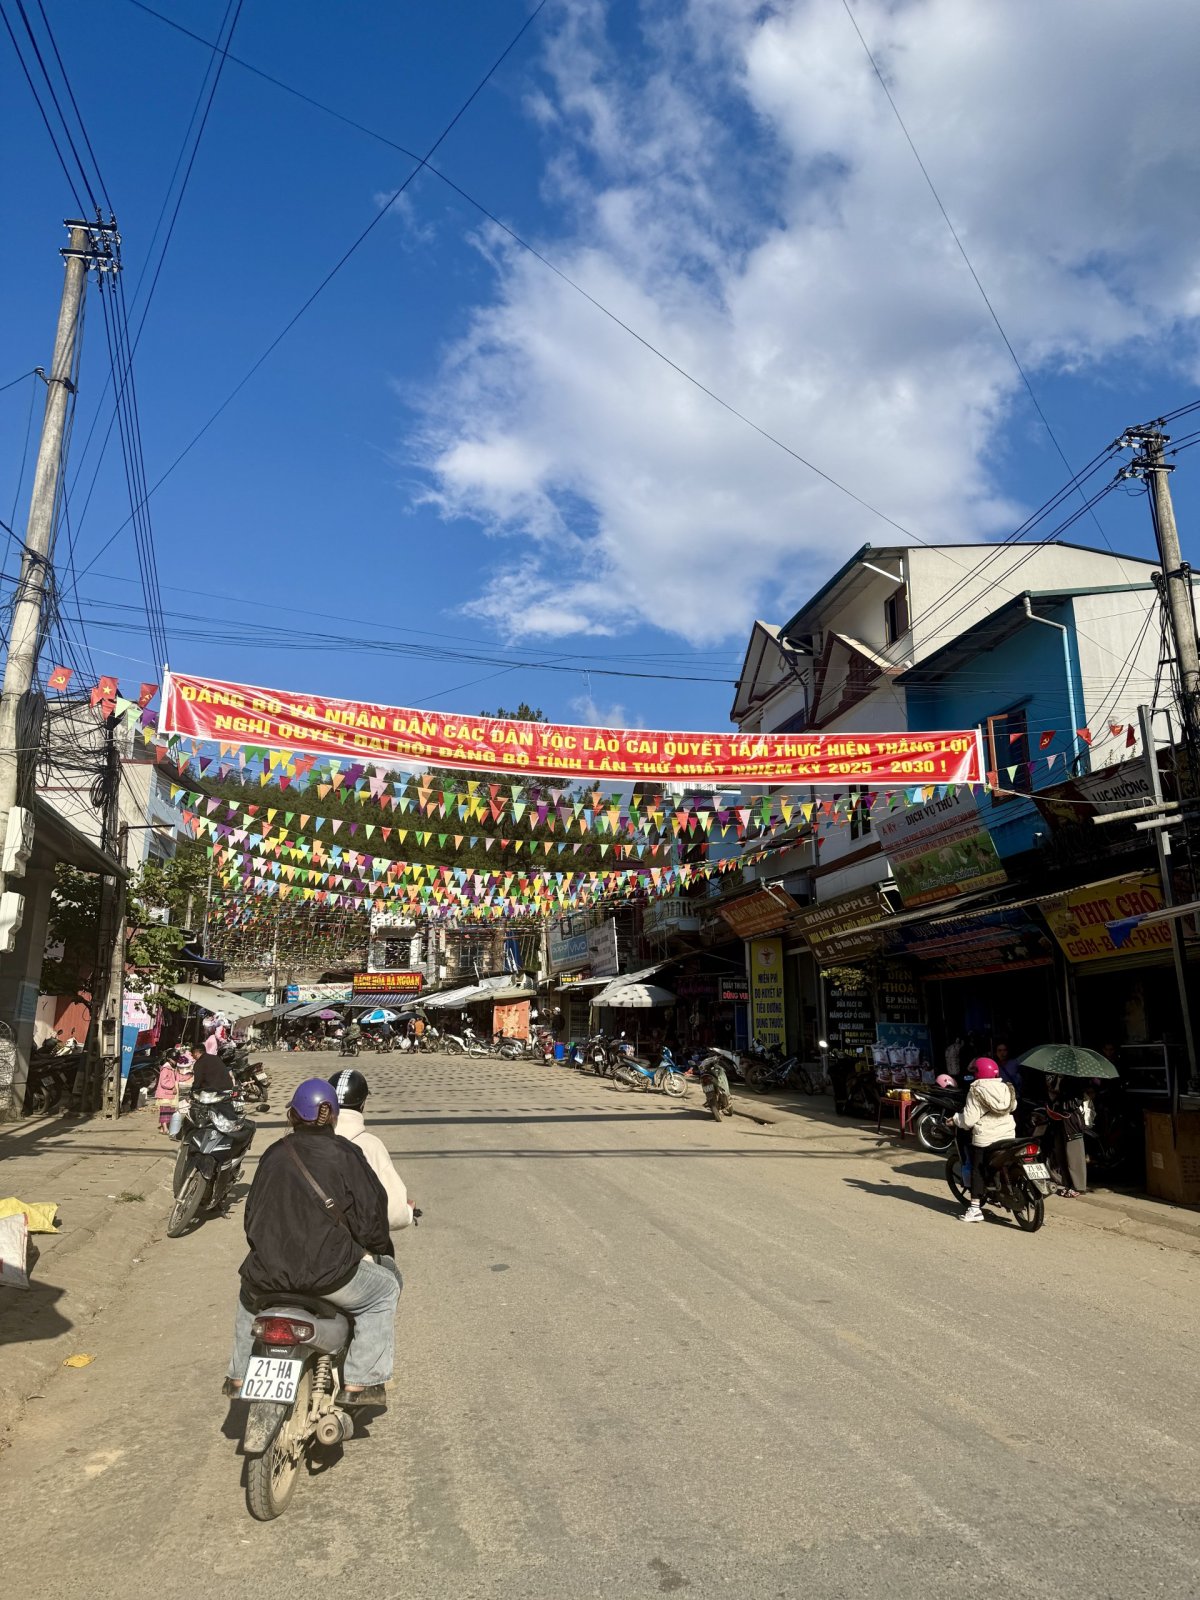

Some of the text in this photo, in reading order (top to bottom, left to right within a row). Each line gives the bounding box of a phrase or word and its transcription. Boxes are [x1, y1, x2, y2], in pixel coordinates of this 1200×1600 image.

[181, 684, 968, 760] ĐẢNG BỘ VÀ NHÂN DÂN CÁC DÂN TỘC LÀO CAI QUYẾT TÂM THỰC HIỆN THẮNG LỢI
[214, 714, 270, 738] NGHỊ
[278, 723, 348, 745] QUYẾT
[354, 735, 390, 752] ĐẠI
[397, 740, 432, 758] HỘI
[438, 743, 496, 763] ĐẢNG
[503, 751, 530, 768] BỘ
[536, 752, 582, 769] TỈNH
[588, 755, 626, 772] LẦN
[632, 760, 670, 774] THỨ
[676, 760, 726, 775] NHẤT
[732, 763, 793, 777] NHIỆM
[799, 761, 821, 774] KỲ
[828, 761, 872, 774] 2025
[891, 760, 935, 774] 2030
[941, 761, 947, 773] !
[905, 810, 924, 826] DỊCH
[924, 808, 935, 818] VỤ
[953, 795, 960, 806] Y
[837, 896, 874, 914] APPLE
[1066, 921, 1172, 957] CƠM-BN-PHỞ
[888, 1026, 897, 1034] A
[254, 1360, 293, 1379] 21-HA
[245, 1380, 294, 1399] 027.66
